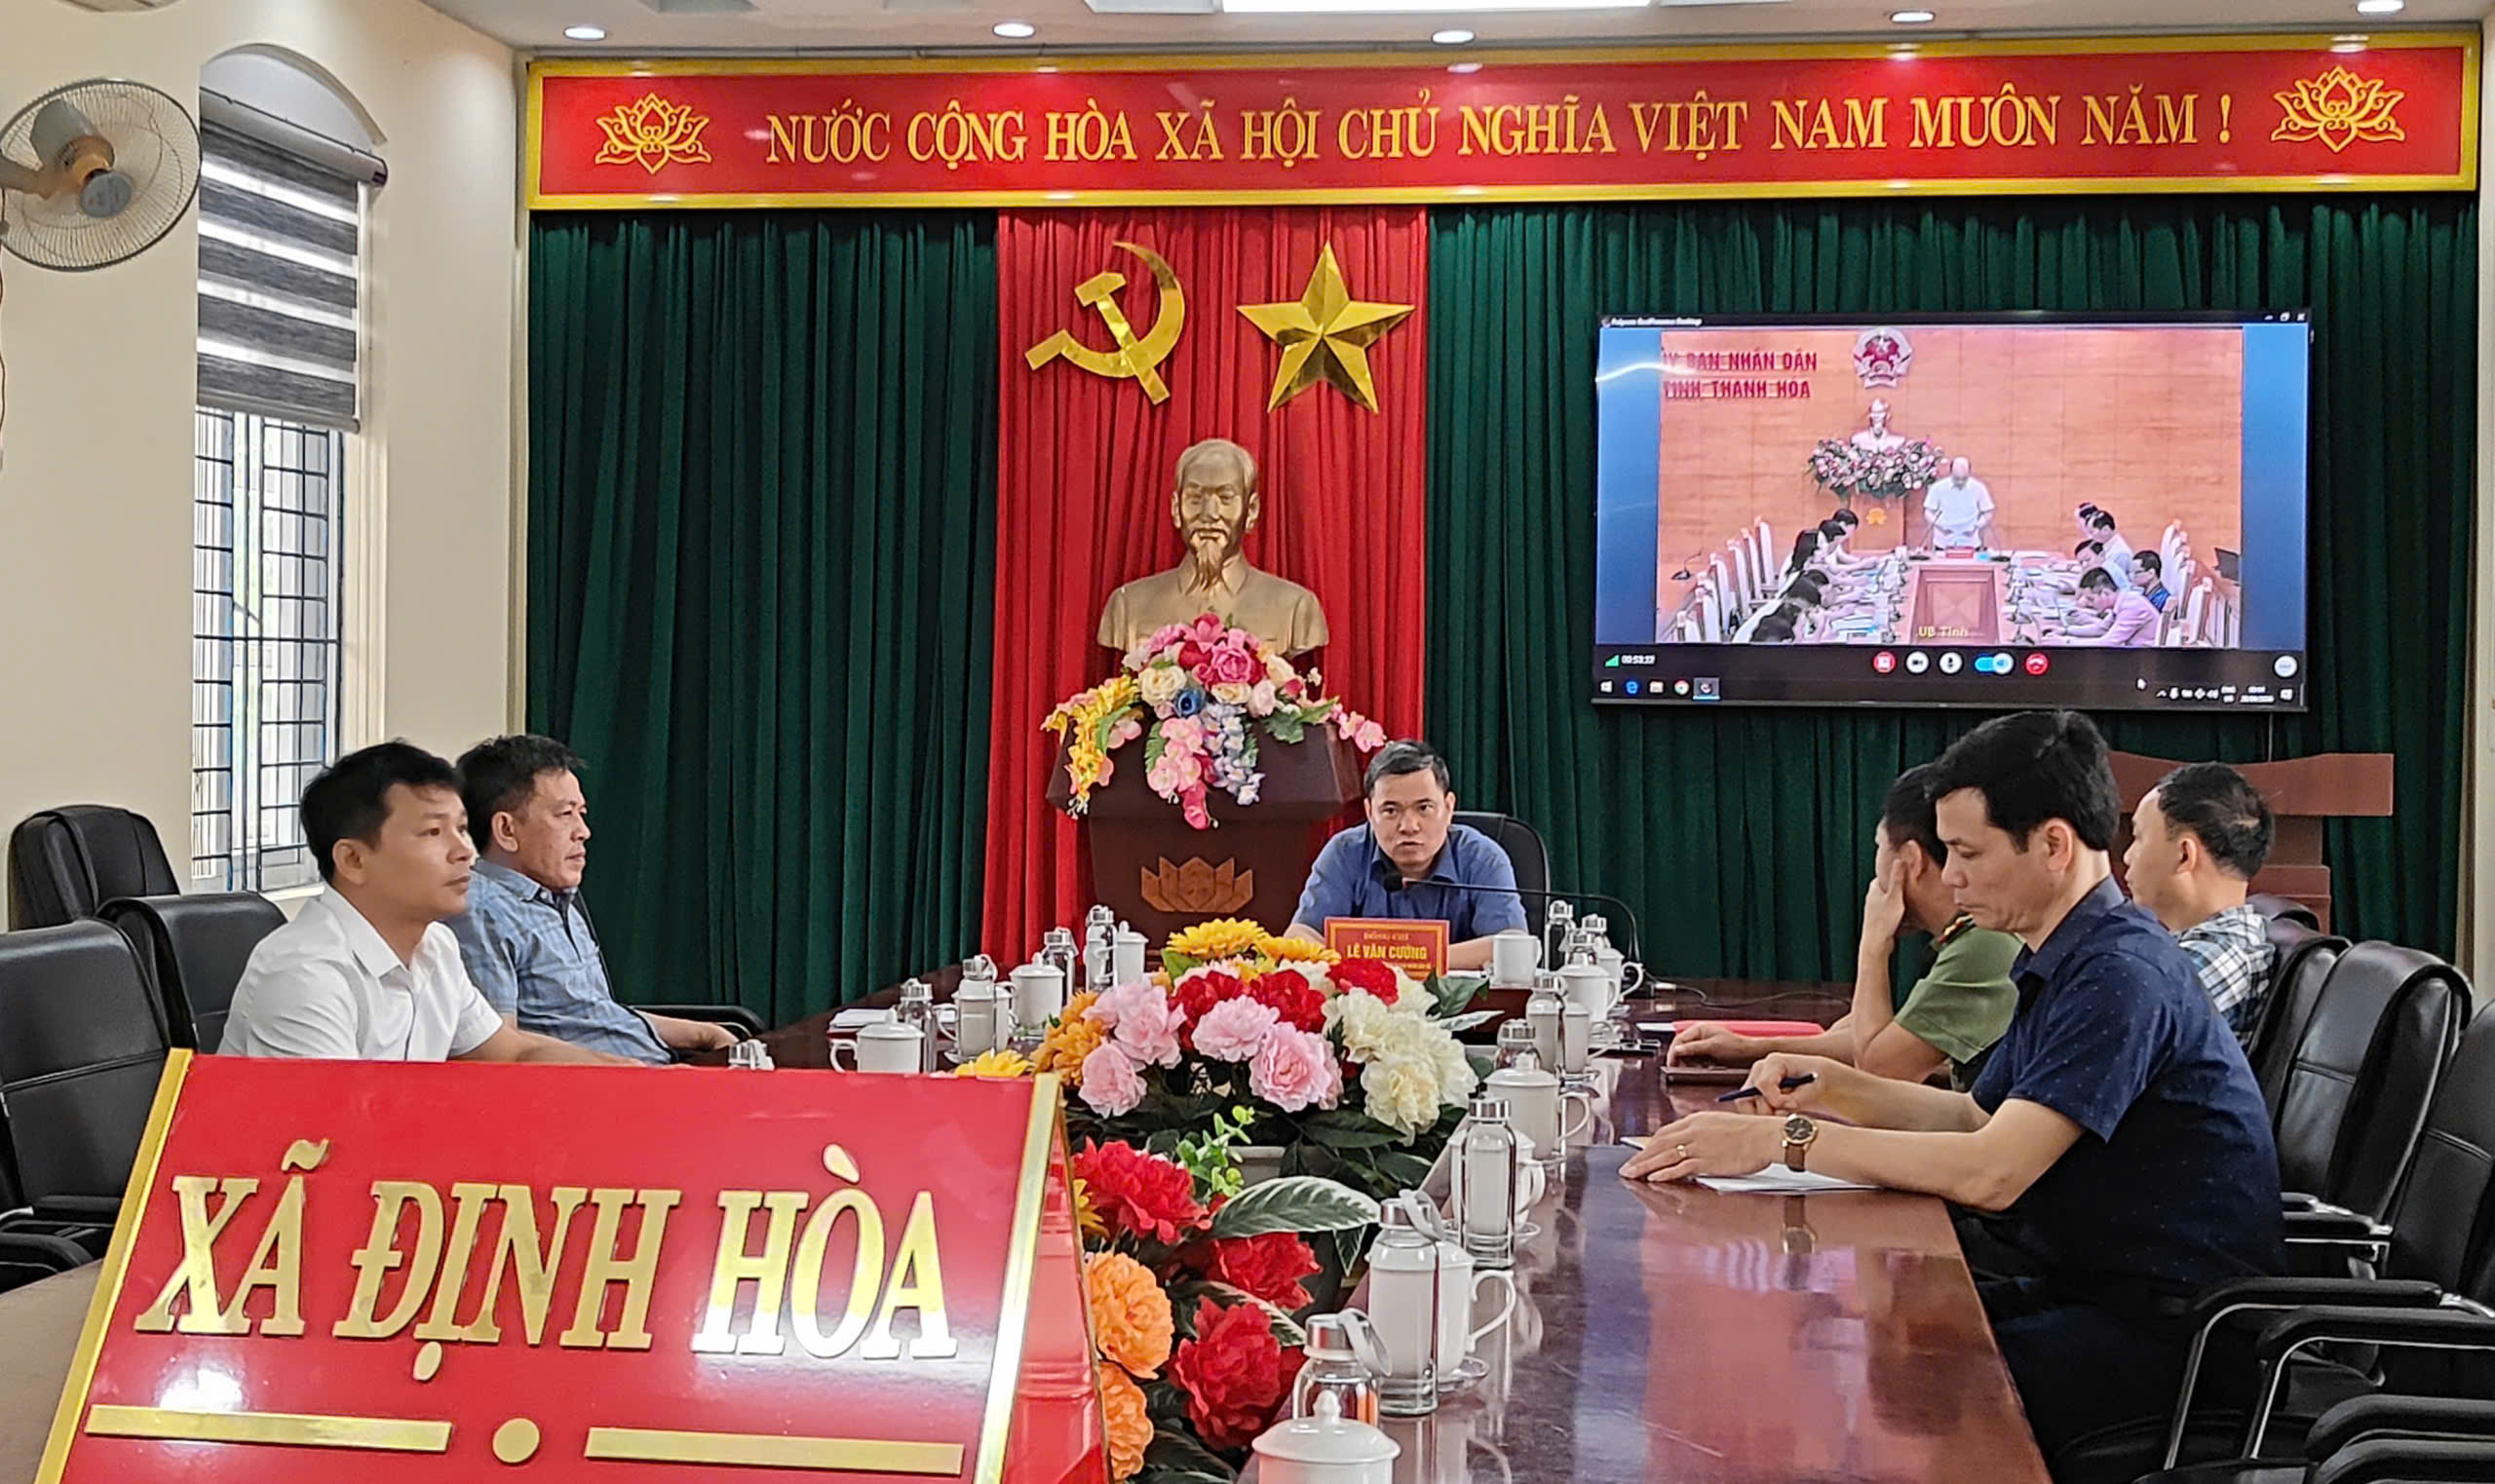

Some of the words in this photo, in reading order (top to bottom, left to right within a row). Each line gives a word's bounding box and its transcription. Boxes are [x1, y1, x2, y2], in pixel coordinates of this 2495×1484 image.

[766, 97, 890, 164] NƯỚC
[906, 99, 1027, 170] CỘNG
[1044, 97, 1137, 161] HÒA
[1155, 98, 1224, 161] XÃ
[1239, 95, 1320, 167] HỘI
[1337, 89, 1440, 159] CHỦ
[1458, 95, 1616, 155] NGHĨA
[1628, 91, 1748, 161] VIỆT
[1770, 97, 1889, 150] NAM
[1910, 82, 2060, 148] MUÔN
[2081, 83, 2199, 145] NĂM
[2217, 94, 2232, 143] !
[1711, 380, 1767, 399] THANH
[133, 1138, 331, 1337] XÃ
[331, 1179, 682, 1383] ĐỊNH
[689, 1142, 959, 1360] HÒA
